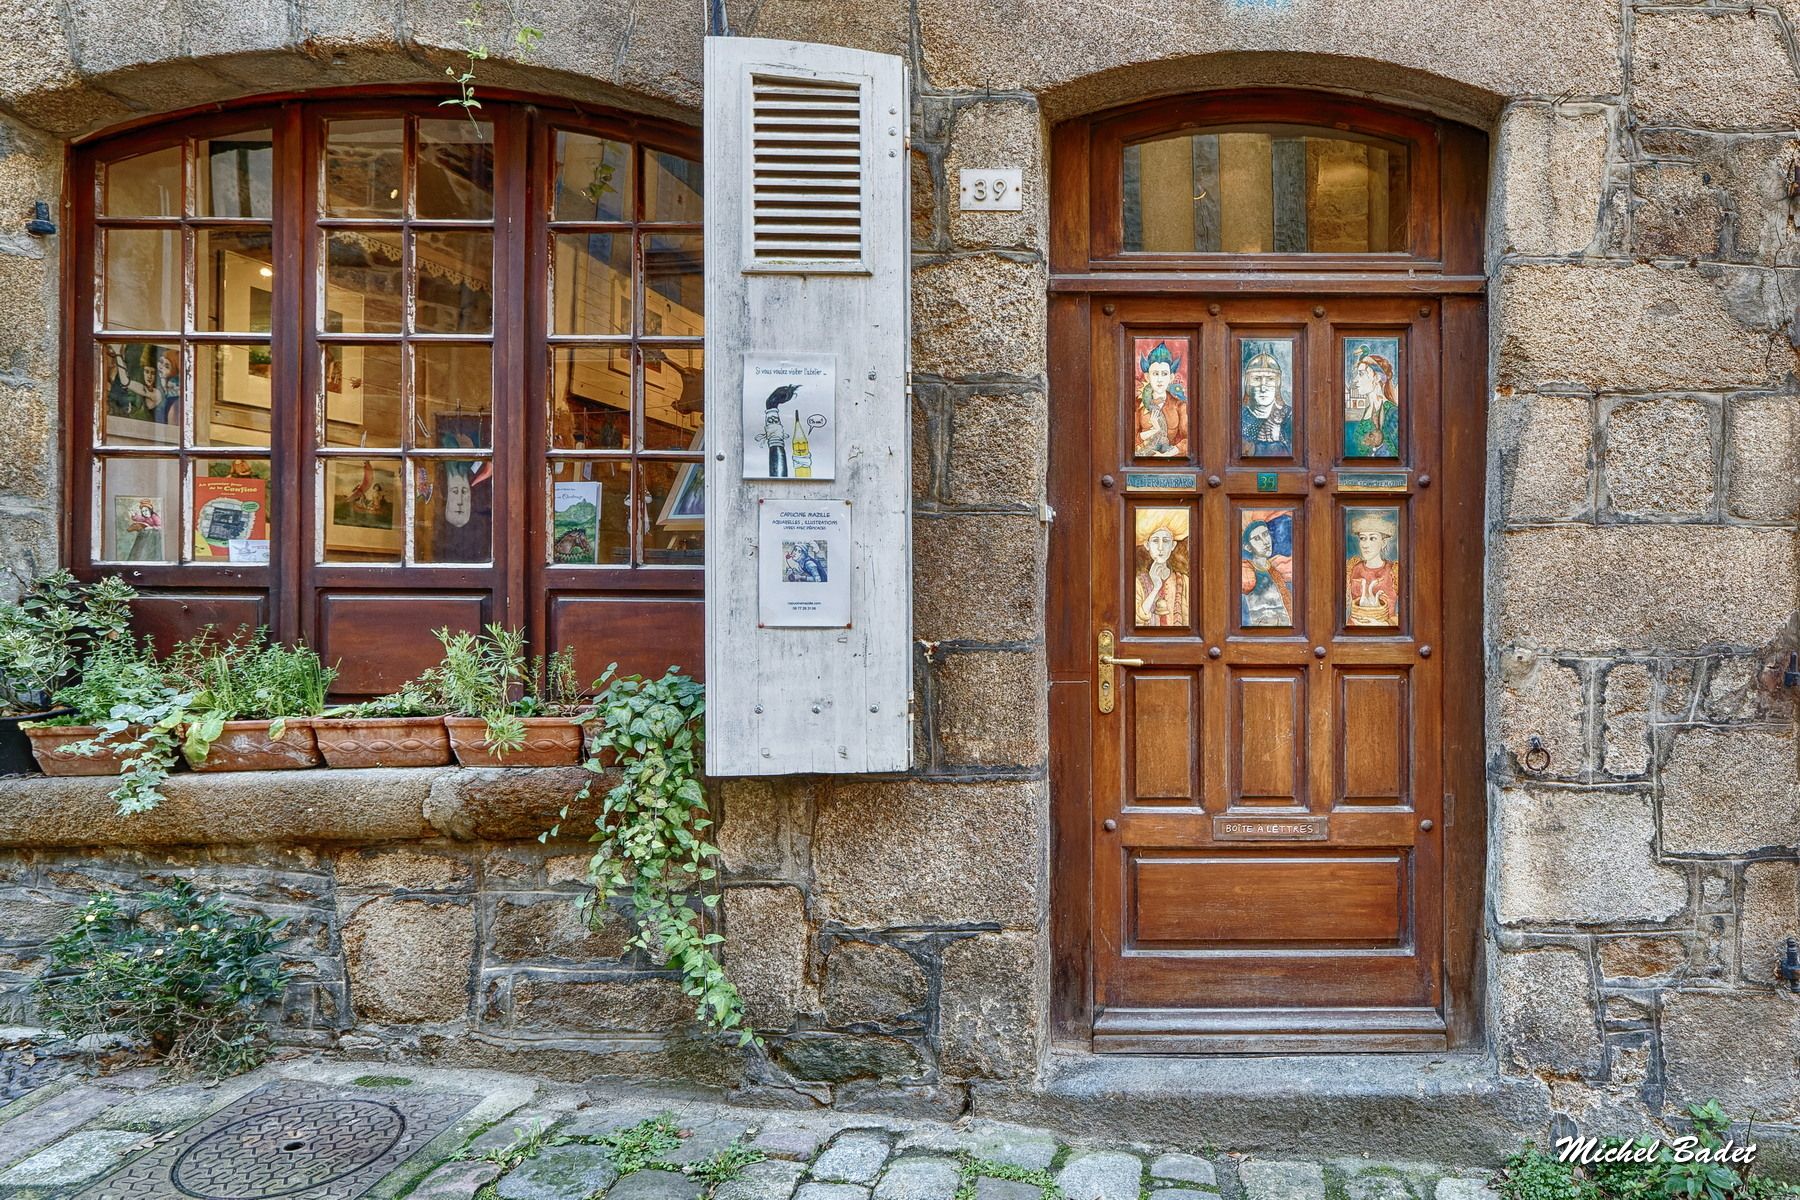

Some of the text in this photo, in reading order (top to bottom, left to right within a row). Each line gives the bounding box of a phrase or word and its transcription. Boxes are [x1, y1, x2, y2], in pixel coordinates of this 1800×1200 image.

[974, 178, 1007, 202] 39
[773, 367, 788, 375] voulez
[1261, 476, 1275, 489] 39
[1226, 823, 1253, 833] BOÎTE
[1266, 824, 1314, 833] LETTRES
